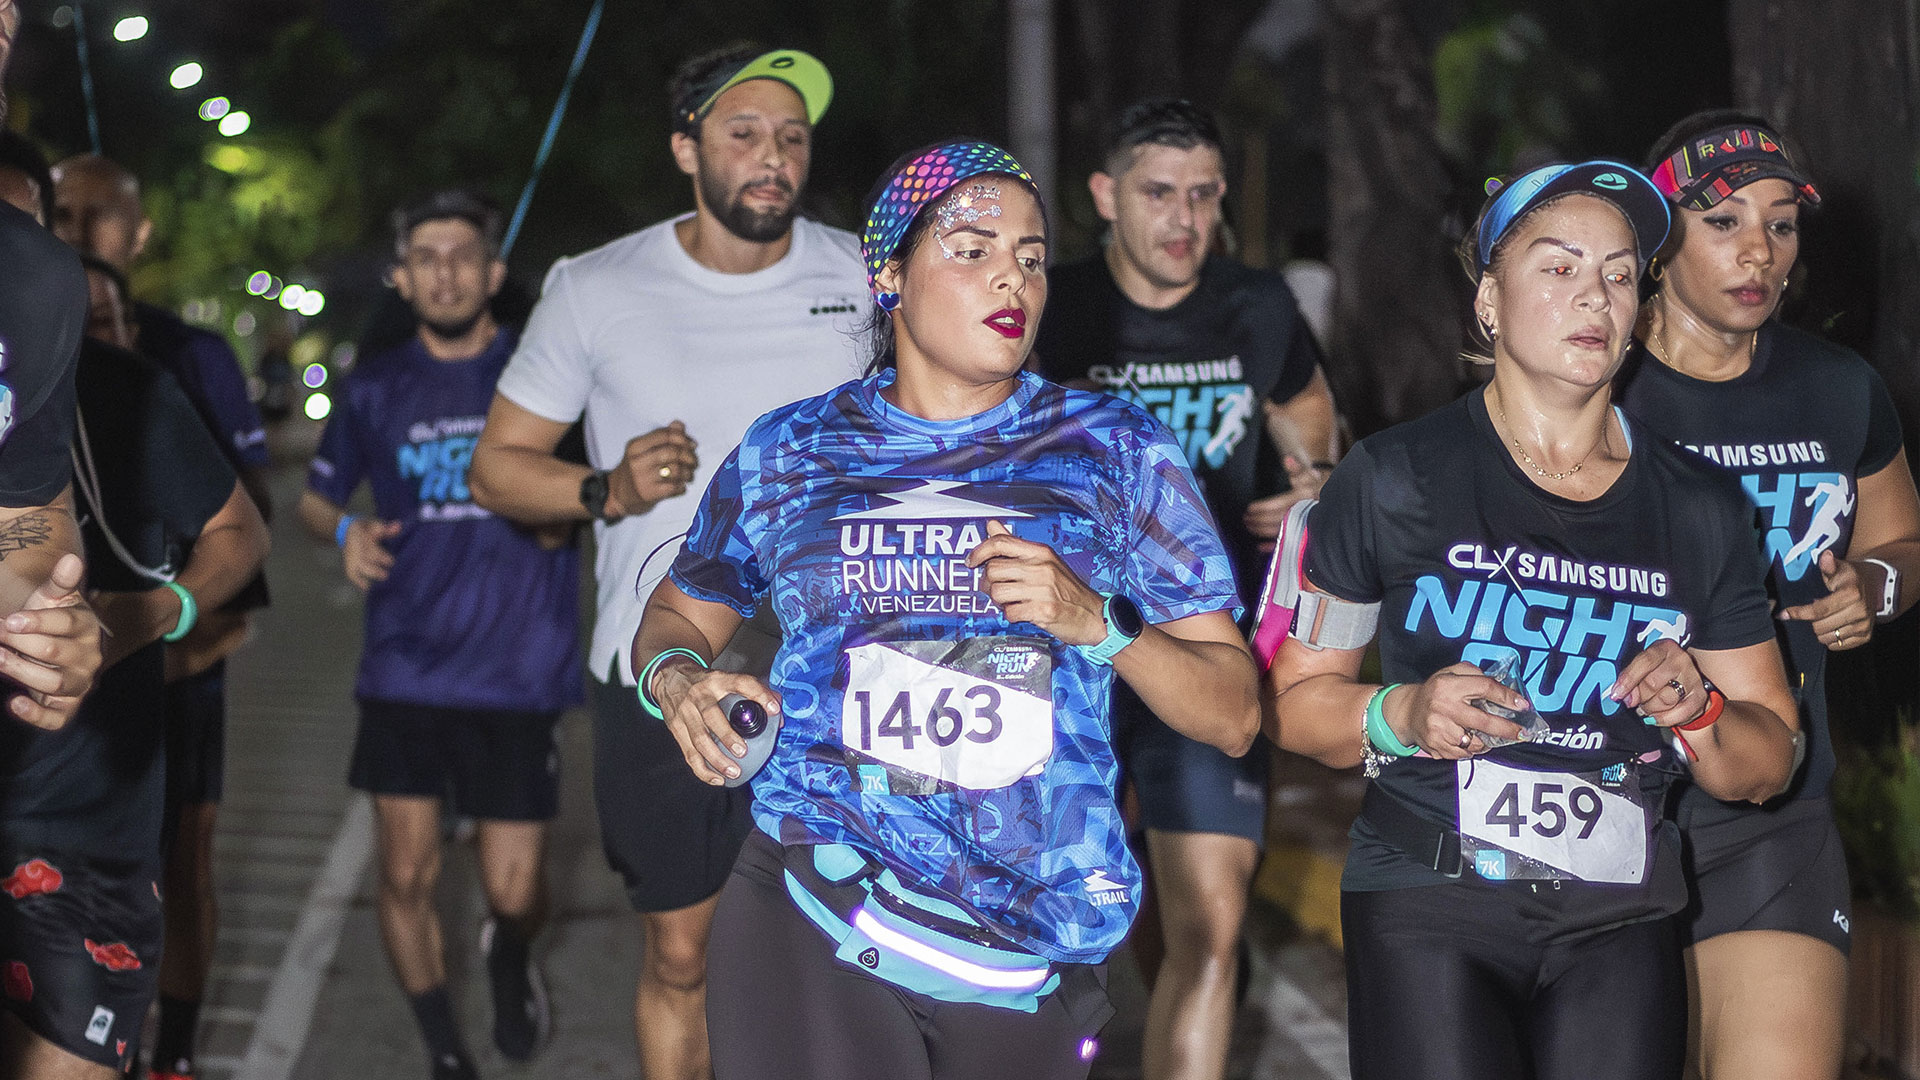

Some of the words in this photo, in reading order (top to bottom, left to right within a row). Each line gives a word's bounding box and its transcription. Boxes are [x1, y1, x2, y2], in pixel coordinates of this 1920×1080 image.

[1135, 356, 1244, 384] SAMSUNG
[1685, 441, 1826, 467] AMSUNG
[840, 524, 1013, 556] ULTRA
[1517, 553, 1667, 597] SAMSUNG
[862, 595, 1000, 615] VENEZUELA
[1404, 575, 1690, 660] NIGHT
[986, 652, 1040, 664] NIGHT
[996, 662, 1031, 673] RUN
[854, 684, 1004, 751] 1463
[863, 775, 885, 791] 7K
[1485, 782, 1604, 840] 459
[1479, 860, 1501, 876] 7K
